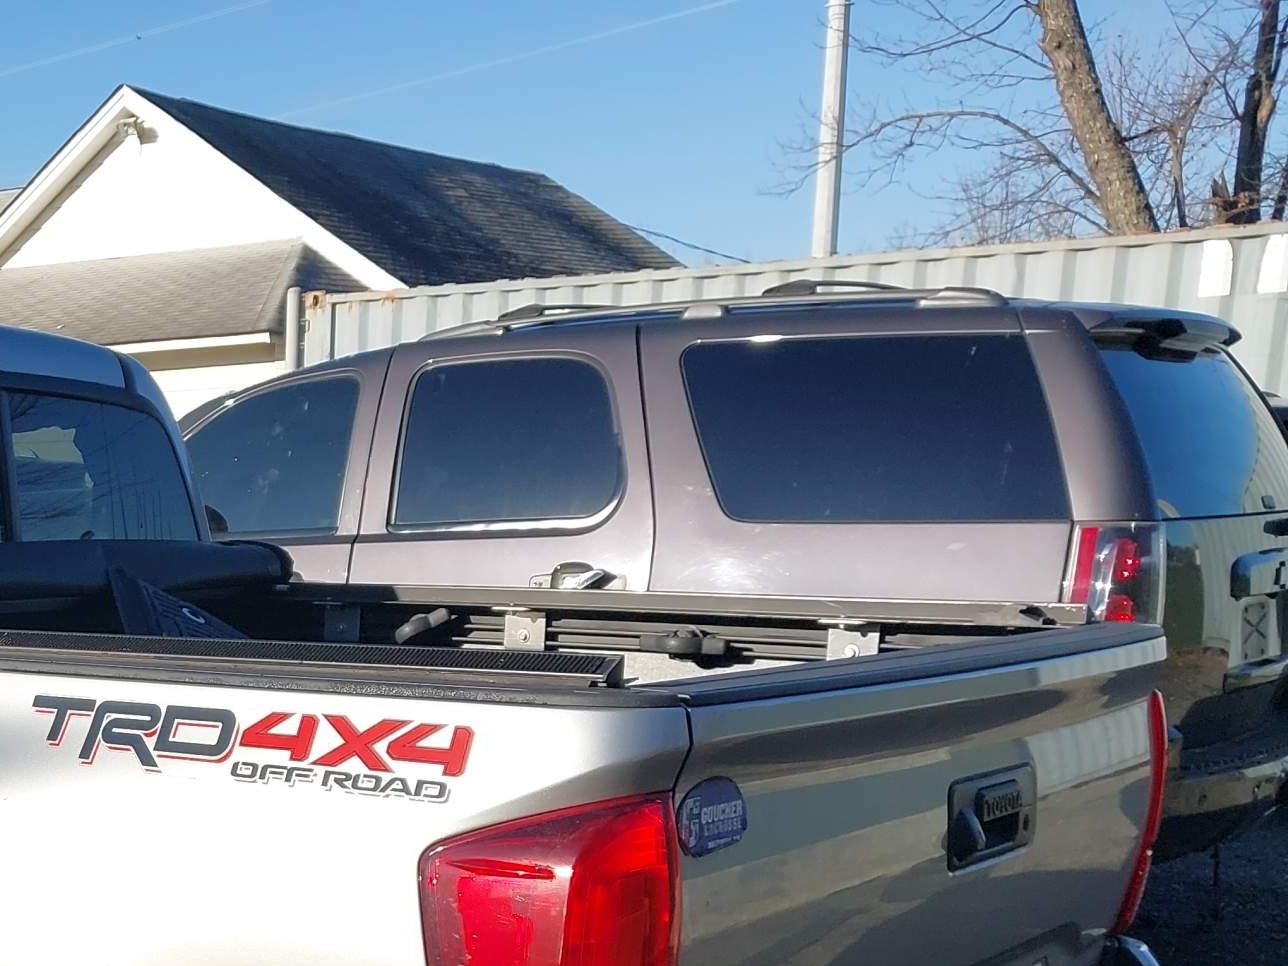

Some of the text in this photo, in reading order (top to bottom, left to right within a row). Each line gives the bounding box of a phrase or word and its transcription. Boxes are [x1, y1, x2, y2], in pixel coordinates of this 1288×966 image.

[32, 694, 240, 773] TRD
[229, 761, 452, 803] OFF ROAD
